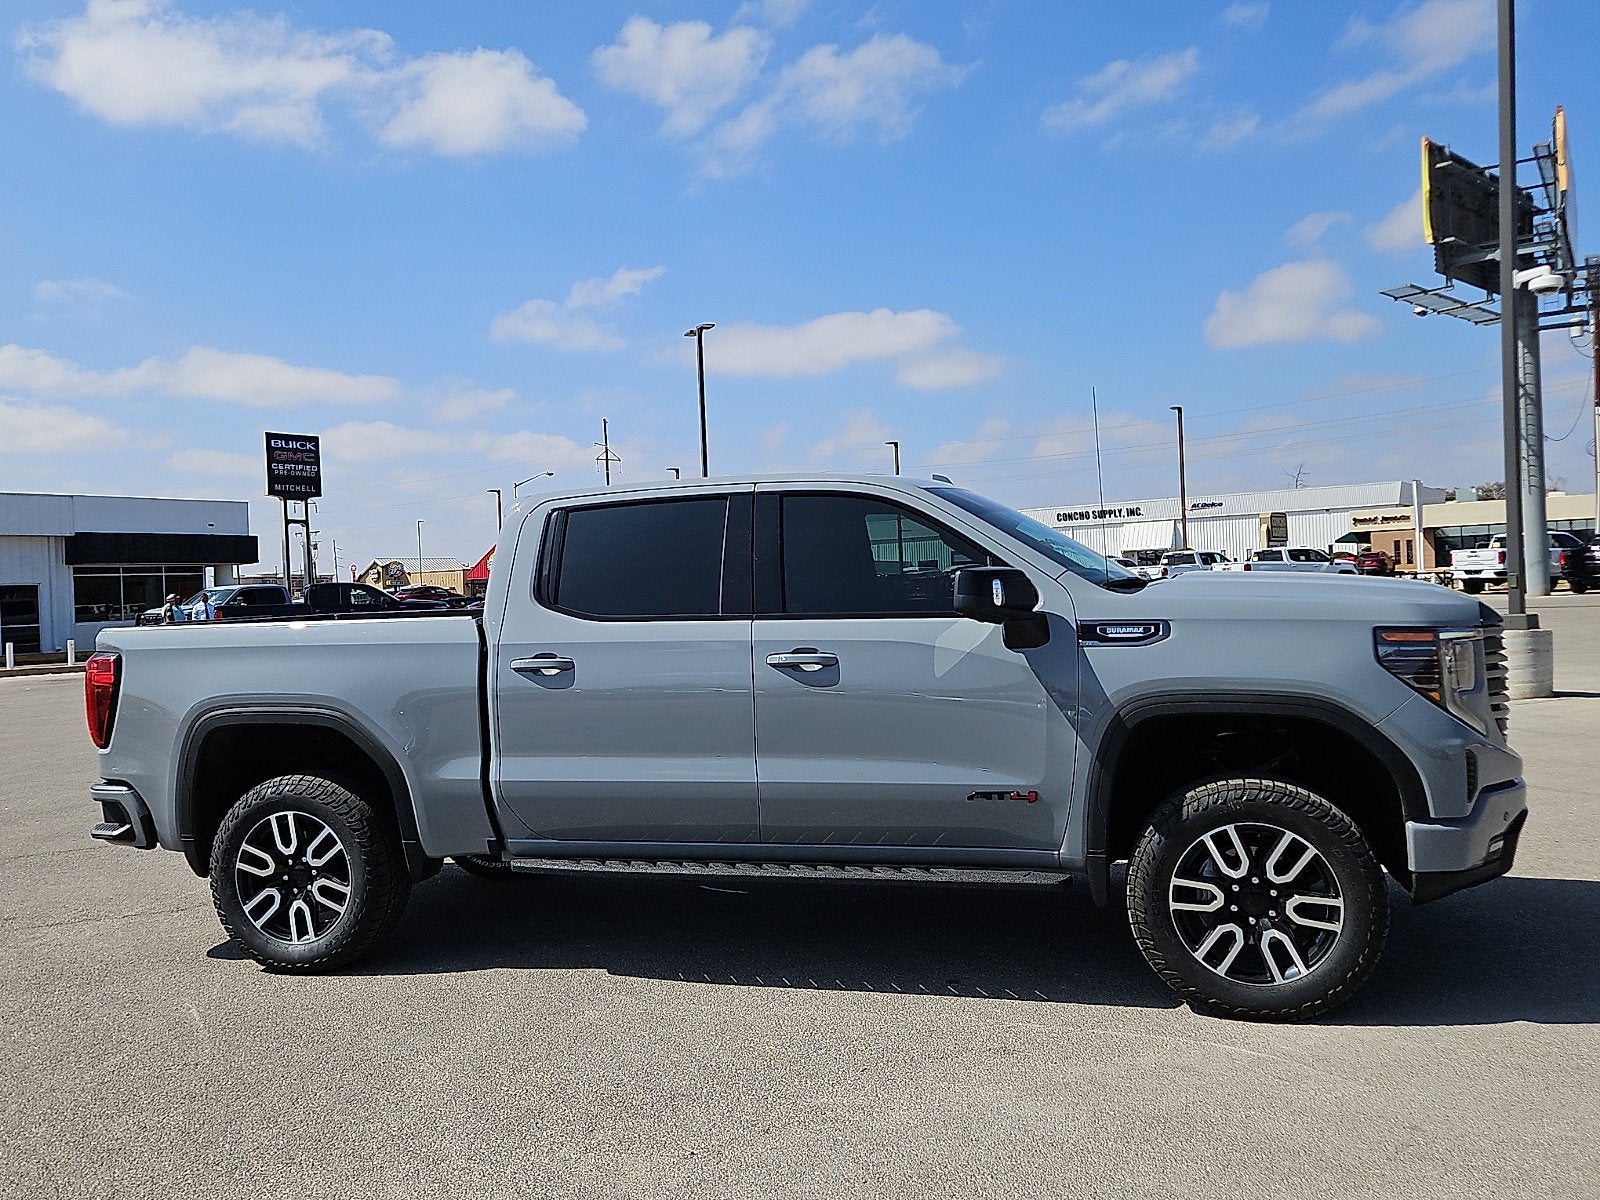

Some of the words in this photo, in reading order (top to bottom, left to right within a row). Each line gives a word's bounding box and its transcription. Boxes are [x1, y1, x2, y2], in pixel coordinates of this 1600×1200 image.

[271, 439, 316, 450] BUICK
[274, 450, 315, 462] GMC
[271, 463, 318, 472] CERTIFIED
[275, 469, 316, 477] PRE-OWNED
[274, 483, 316, 492] MITCHELL
[1056, 511, 1091, 522] CONCHO
[1092, 508, 1125, 520] SUPPLY,
[1126, 506, 1144, 517] INC.
[966, 790, 1038, 804] AT4
